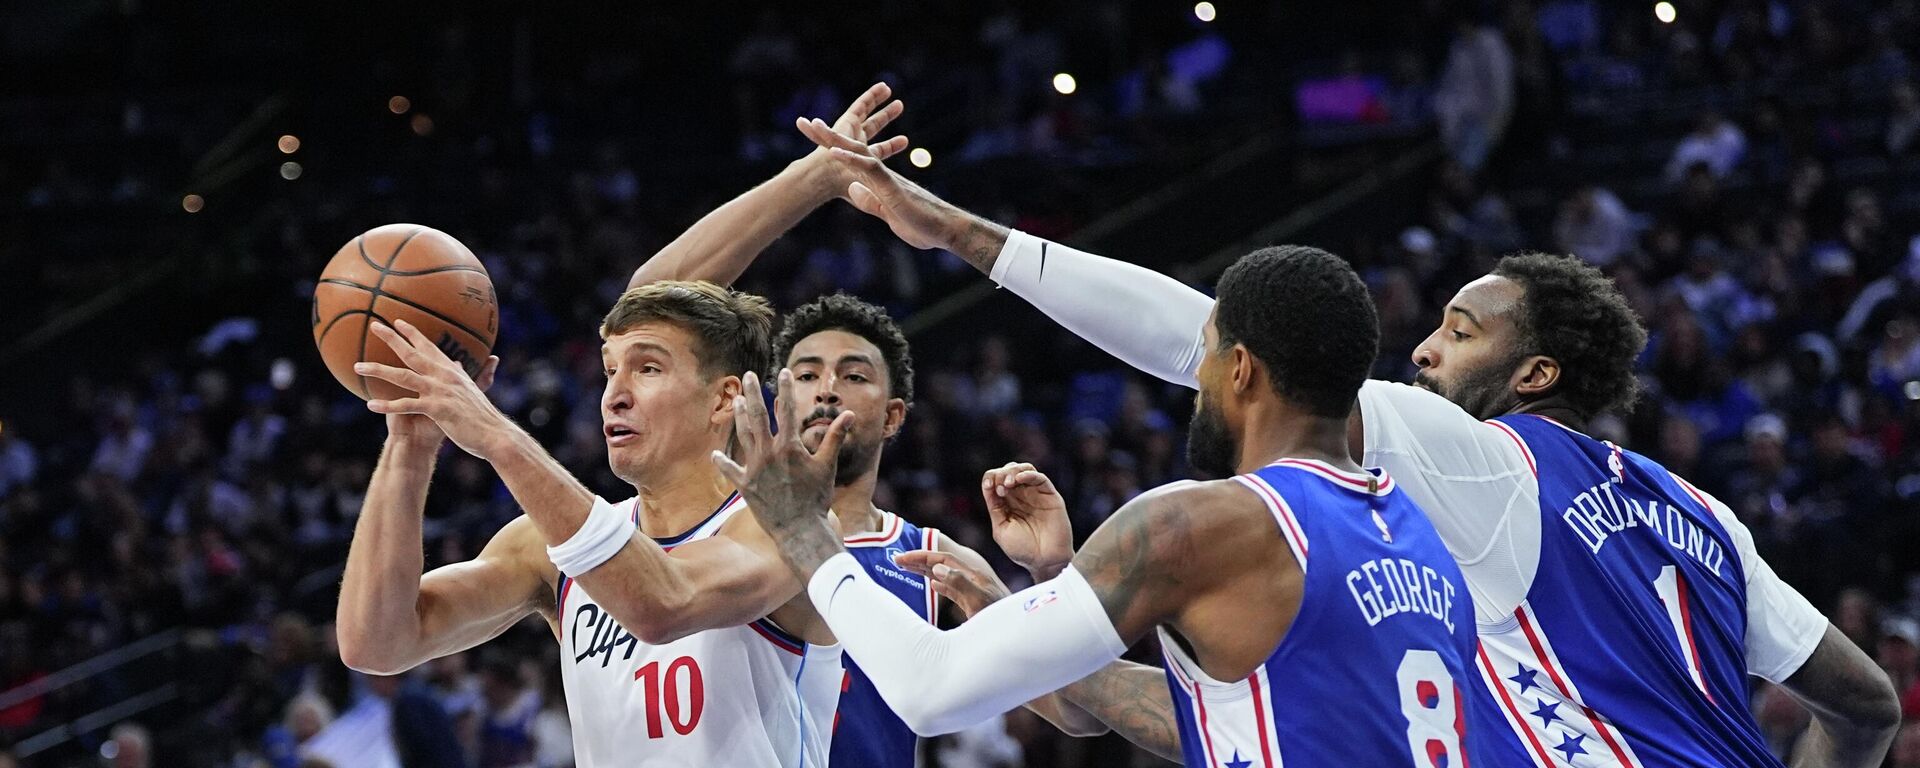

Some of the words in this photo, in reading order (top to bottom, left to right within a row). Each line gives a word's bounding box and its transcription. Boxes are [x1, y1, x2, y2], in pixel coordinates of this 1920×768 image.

[875, 564, 924, 590] crypto.com
[1346, 558, 1455, 635] GEORGE
[1653, 565, 1710, 701] 1
[634, 655, 705, 739] 10
[1396, 649, 1466, 768] 8
